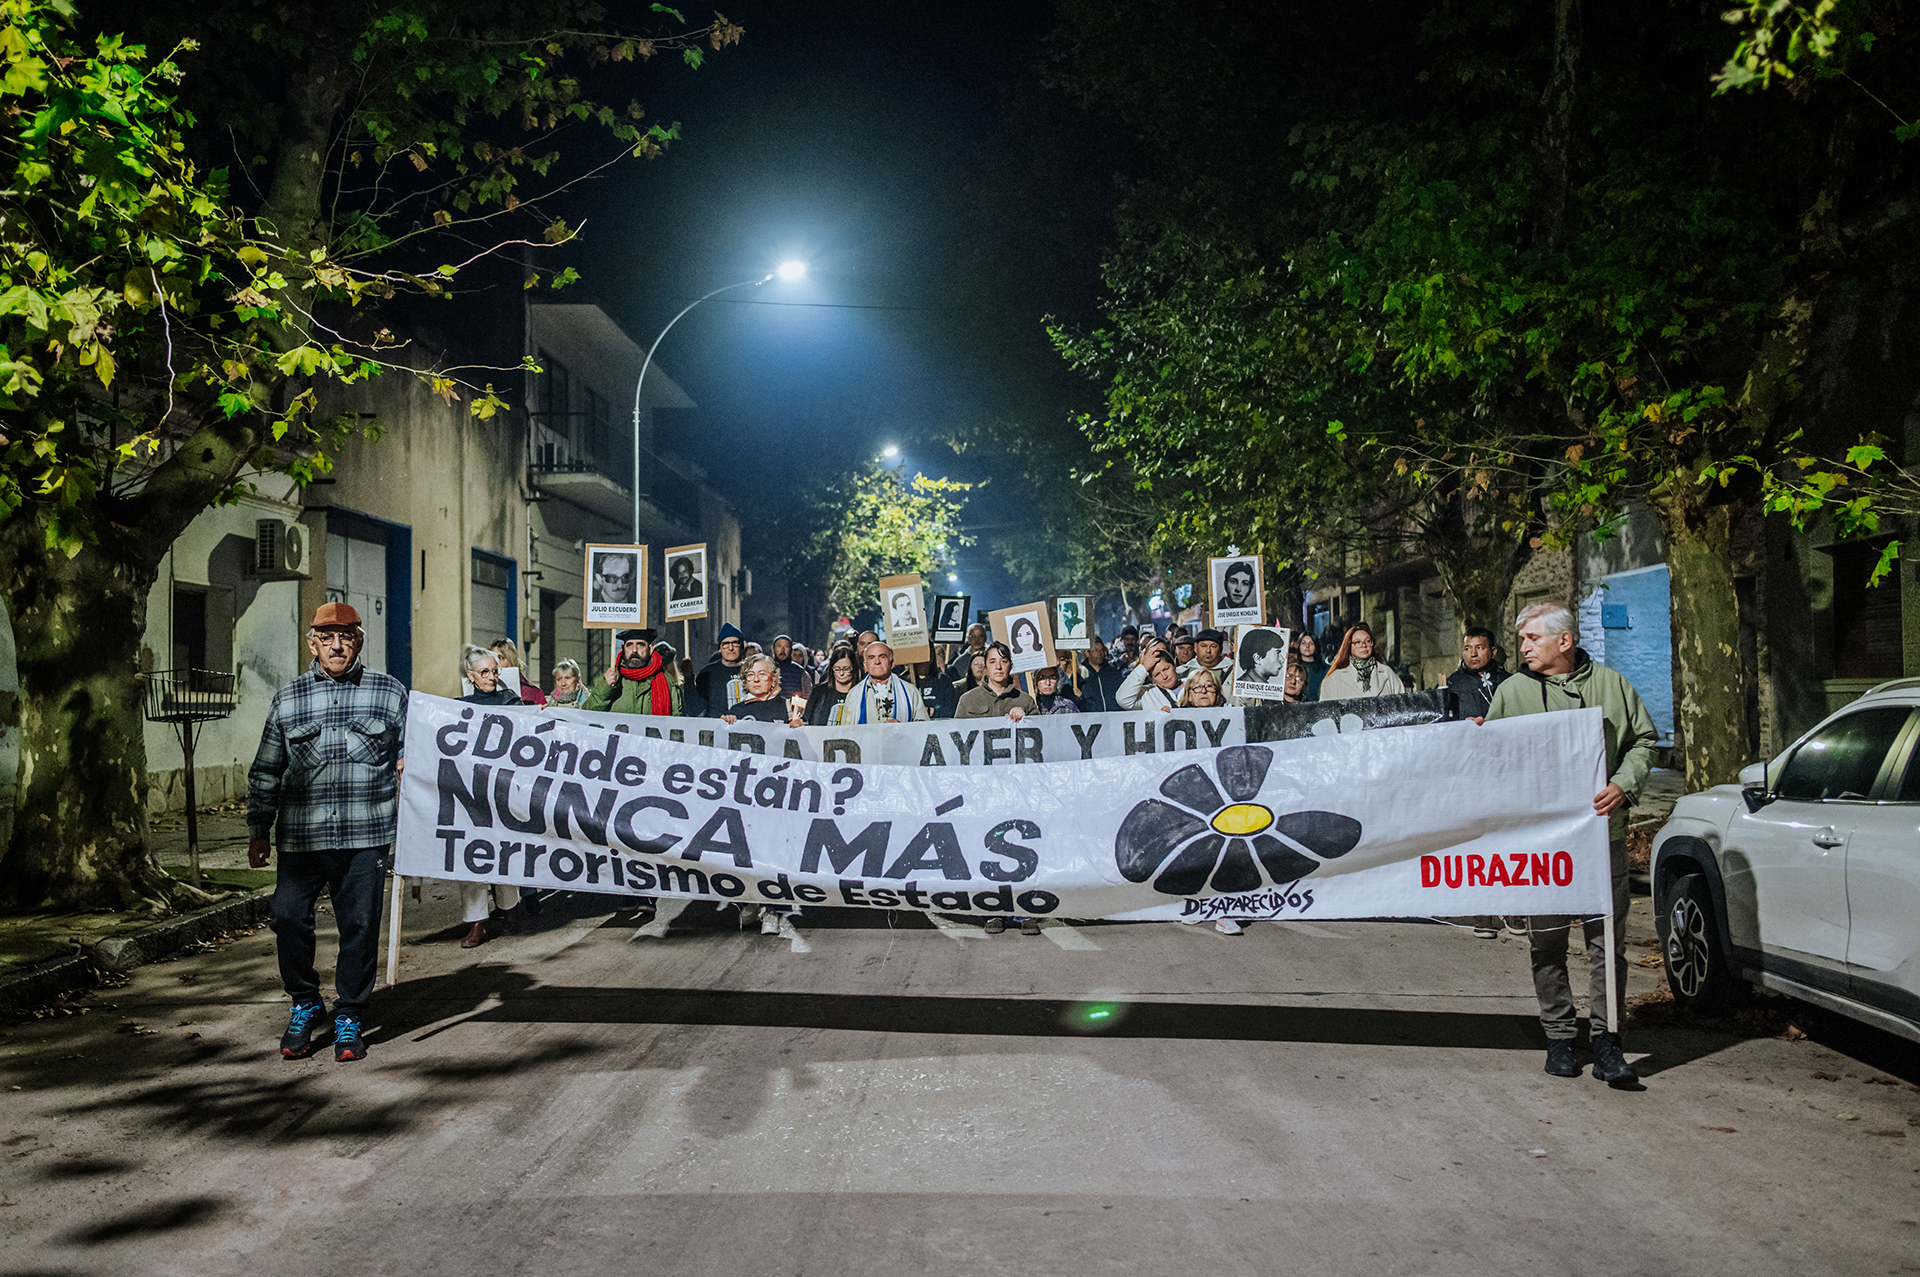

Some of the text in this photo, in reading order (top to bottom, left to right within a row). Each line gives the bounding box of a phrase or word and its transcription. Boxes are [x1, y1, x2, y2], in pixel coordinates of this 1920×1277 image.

[1246, 683, 1264, 691] ENRIQUE
[436, 707, 864, 816] ¿Dónde están?
[919, 727, 1044, 766] AYER
[1070, 723, 1102, 760] Y
[1123, 718, 1231, 757] HOY
[437, 758, 1042, 882] NUNCA MÁS
[436, 828, 1060, 913] Terrorismo de Estado
[1421, 851, 1573, 888] DURAZNO
